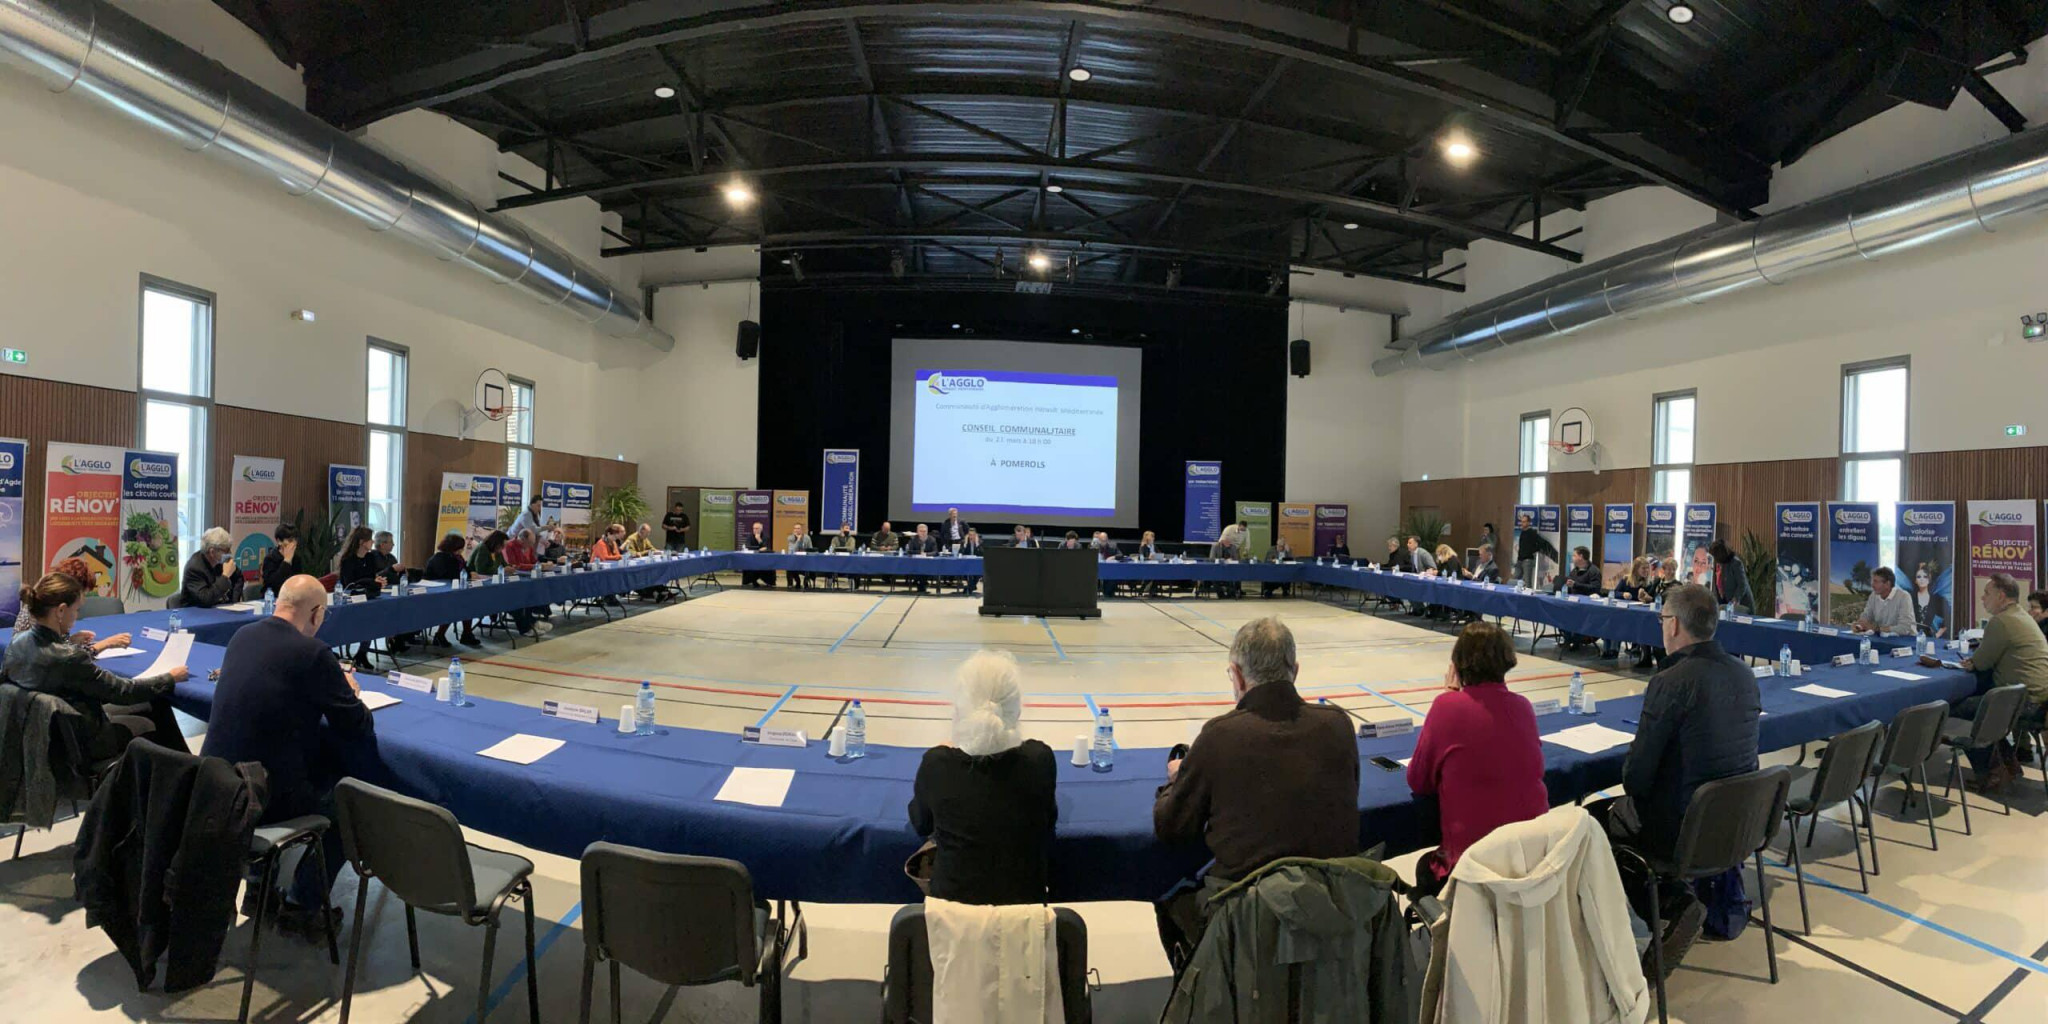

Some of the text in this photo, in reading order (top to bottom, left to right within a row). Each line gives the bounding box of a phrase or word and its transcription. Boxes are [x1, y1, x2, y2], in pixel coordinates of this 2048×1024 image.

[941, 378, 985, 388] L'AGGLO
[962, 424, 995, 433] CONSEIL
[74, 458, 112, 470] L'AGGLO
[141, 463, 170, 473] L'AGGLO
[1000, 460, 1046, 469] POMEROLS
[251, 470, 276, 478] L'AGGLO
[134, 481, 168, 490] développe
[76, 490, 117, 500] OBJECTIF
[50, 496, 119, 514] RÉNOV'
[234, 500, 280, 514] RÉNOV'
[1842, 512, 1869, 520] L'AGGLO
[1988, 512, 2022, 520] L'AGGLO
[1972, 544, 2032, 560] RÉNOV'
